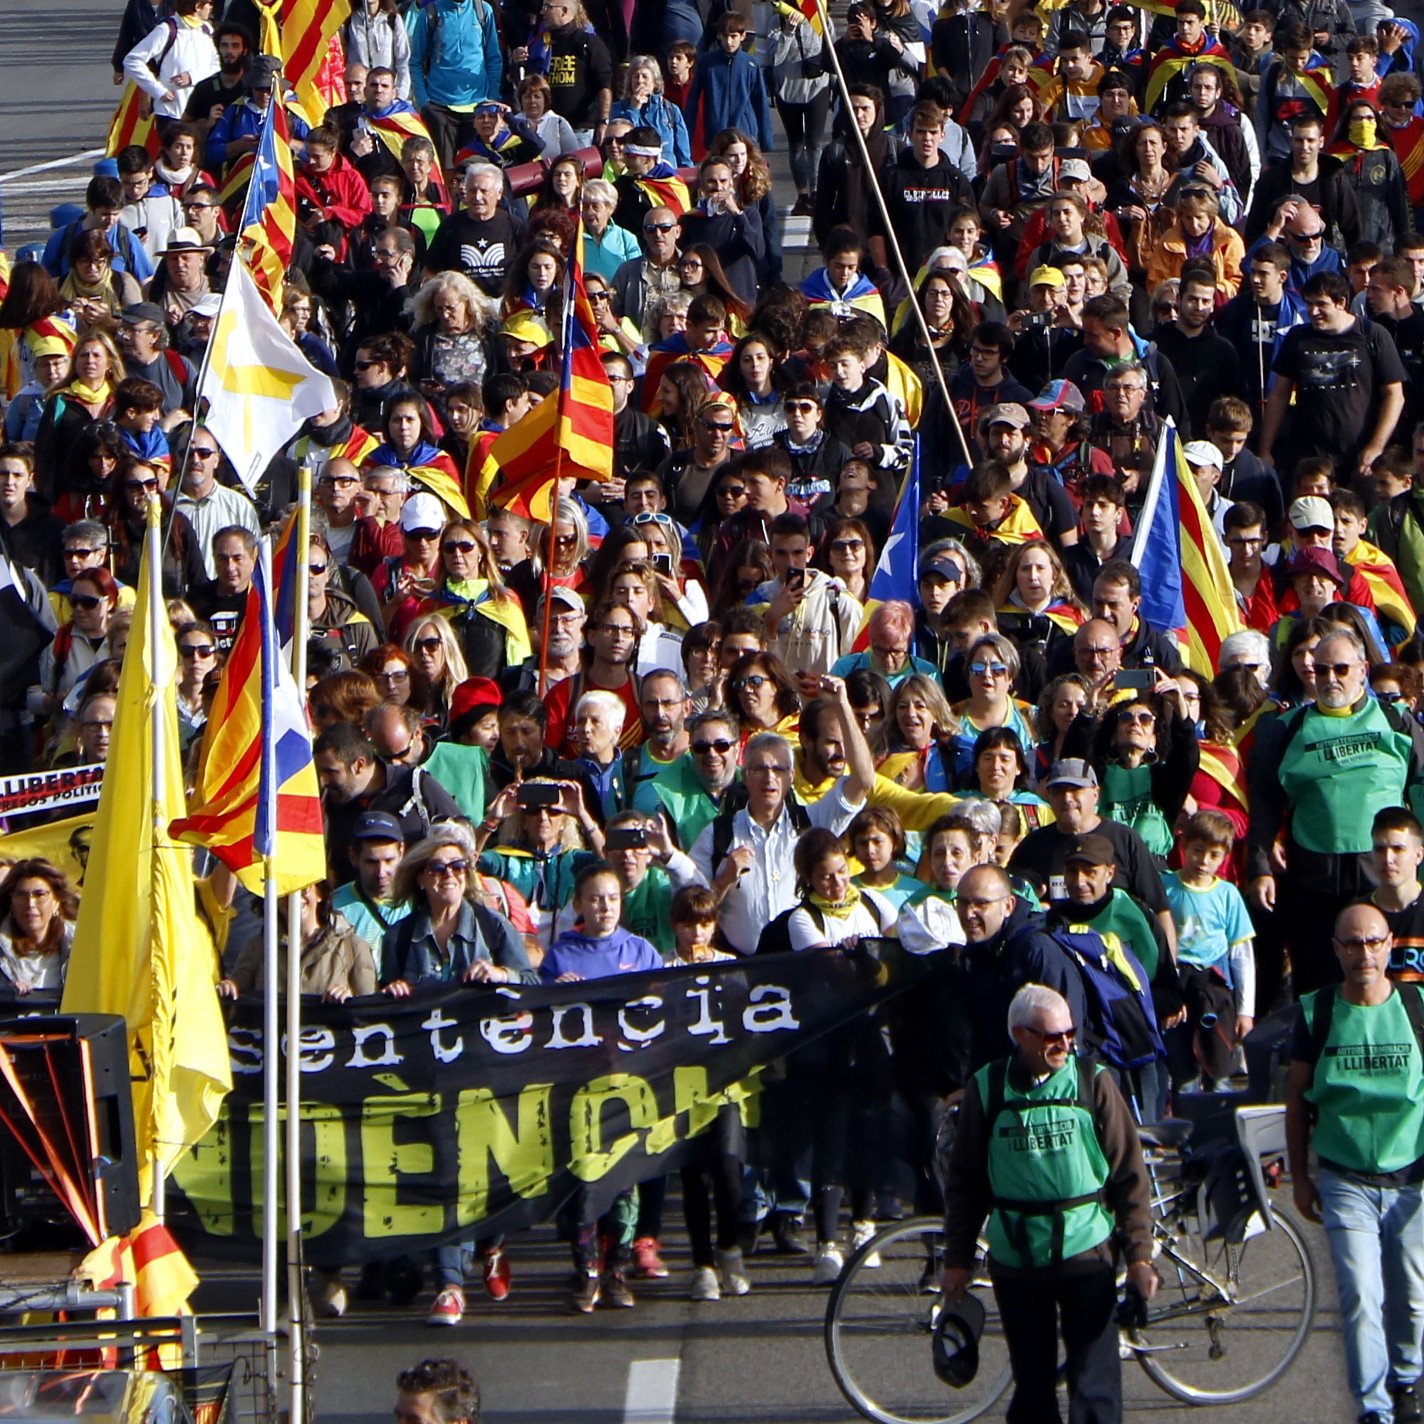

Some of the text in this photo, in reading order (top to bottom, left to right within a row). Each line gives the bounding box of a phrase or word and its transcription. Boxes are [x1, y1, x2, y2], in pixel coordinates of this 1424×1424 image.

[1322, 740, 1378, 761] LLIBERTAT
[226, 978, 801, 1075] sentència
[1342, 1055, 1410, 1071] LLIBERTAT
[1013, 1133, 1073, 1152] LLIBERTAT
